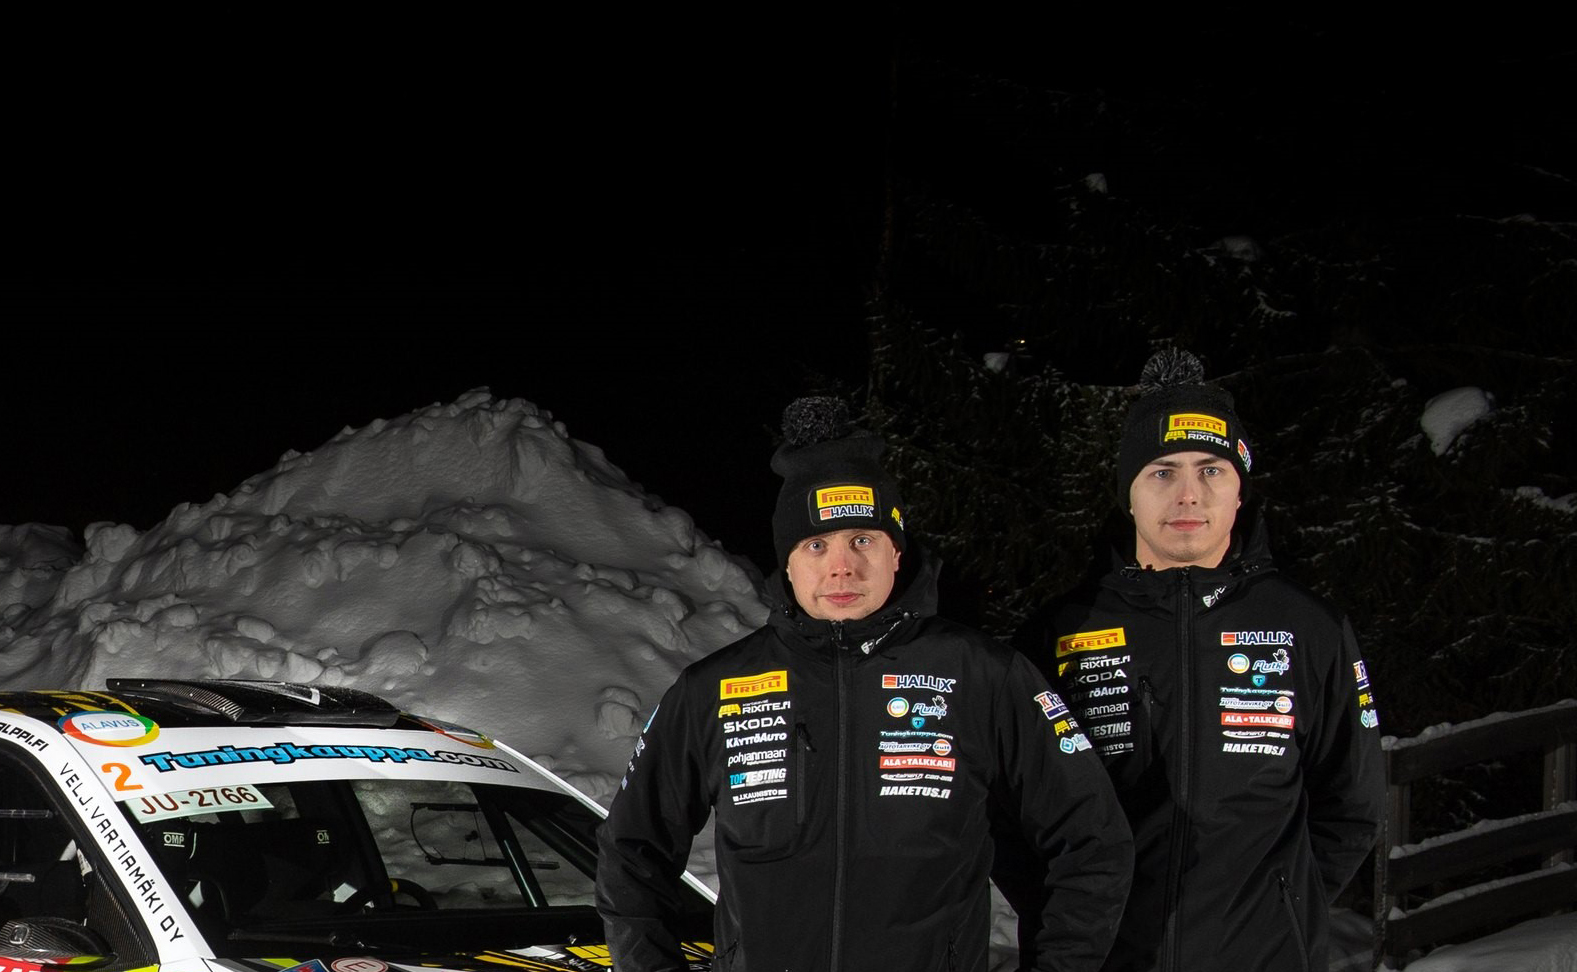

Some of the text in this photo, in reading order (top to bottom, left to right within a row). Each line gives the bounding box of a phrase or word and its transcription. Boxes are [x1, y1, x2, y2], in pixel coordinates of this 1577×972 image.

[1174, 418, 1222, 432] PIRELLI
[822, 489, 870, 503] PIRELLI
[831, 505, 874, 518] HALLIX
[1059, 633, 1119, 652] PIRELLI
[1236, 631, 1293, 646] HALLIX
[725, 675, 781, 695] PIRELLI
[897, 674, 953, 692] HALLIX
[81, 719, 140, 731] ALAVUS
[723, 716, 786, 733] SKODA
[138, 742, 521, 773] Tuningkauppa.com
[728, 749, 786, 767] pohjanmaan
[101, 762, 144, 791] 2
[140, 786, 259, 815] JU-2766
[880, 786, 951, 799] HAKETUS.fi
[164, 833, 185, 845] OMP
[160, 915, 184, 942] OY
